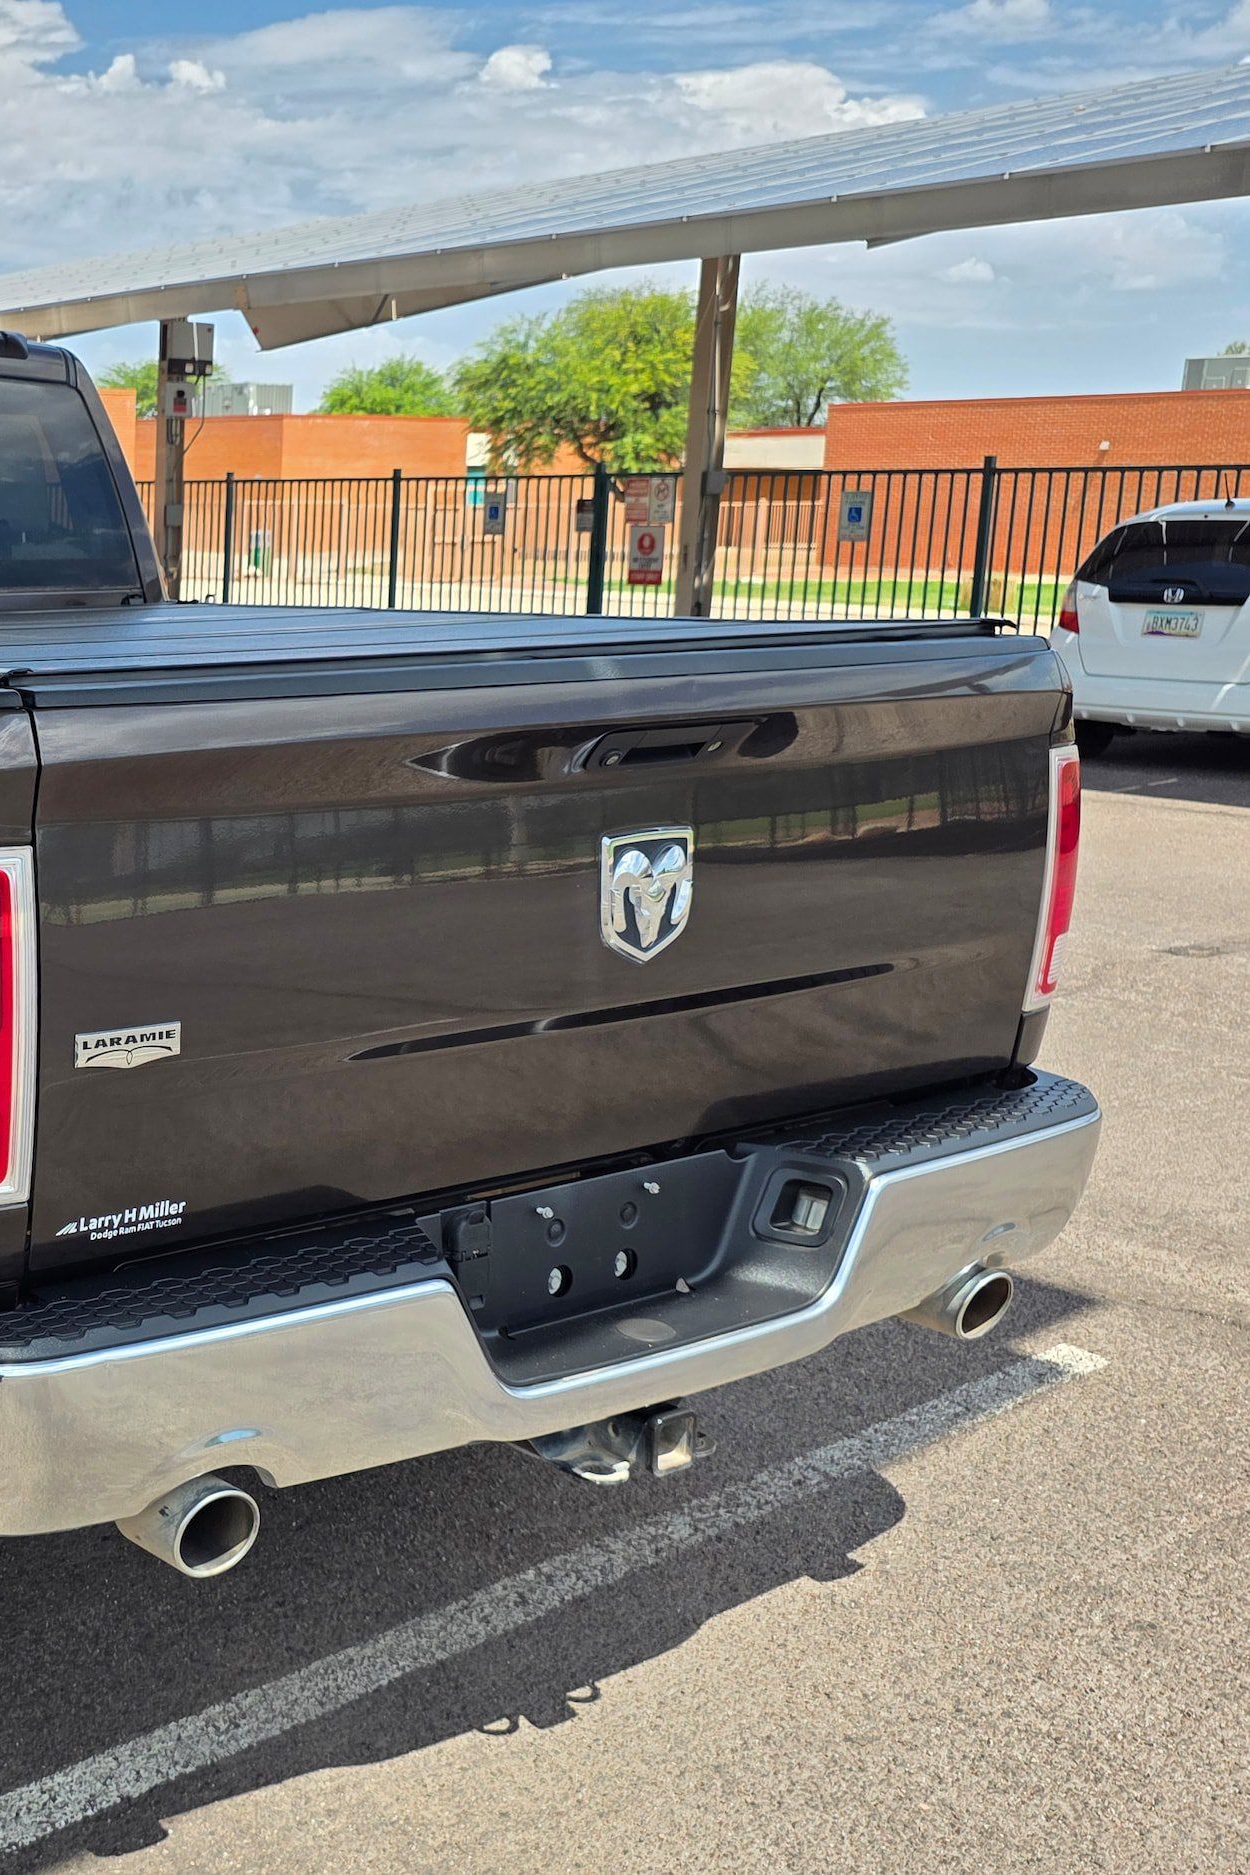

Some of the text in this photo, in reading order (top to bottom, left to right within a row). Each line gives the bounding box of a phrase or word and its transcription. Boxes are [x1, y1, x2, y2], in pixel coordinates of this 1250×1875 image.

[82, 1029, 176, 1050] LARAMIE
[79, 1200, 187, 1232] Larry H Miller
[90, 1217, 182, 1241] Dodge Ram FIAT Tucson
